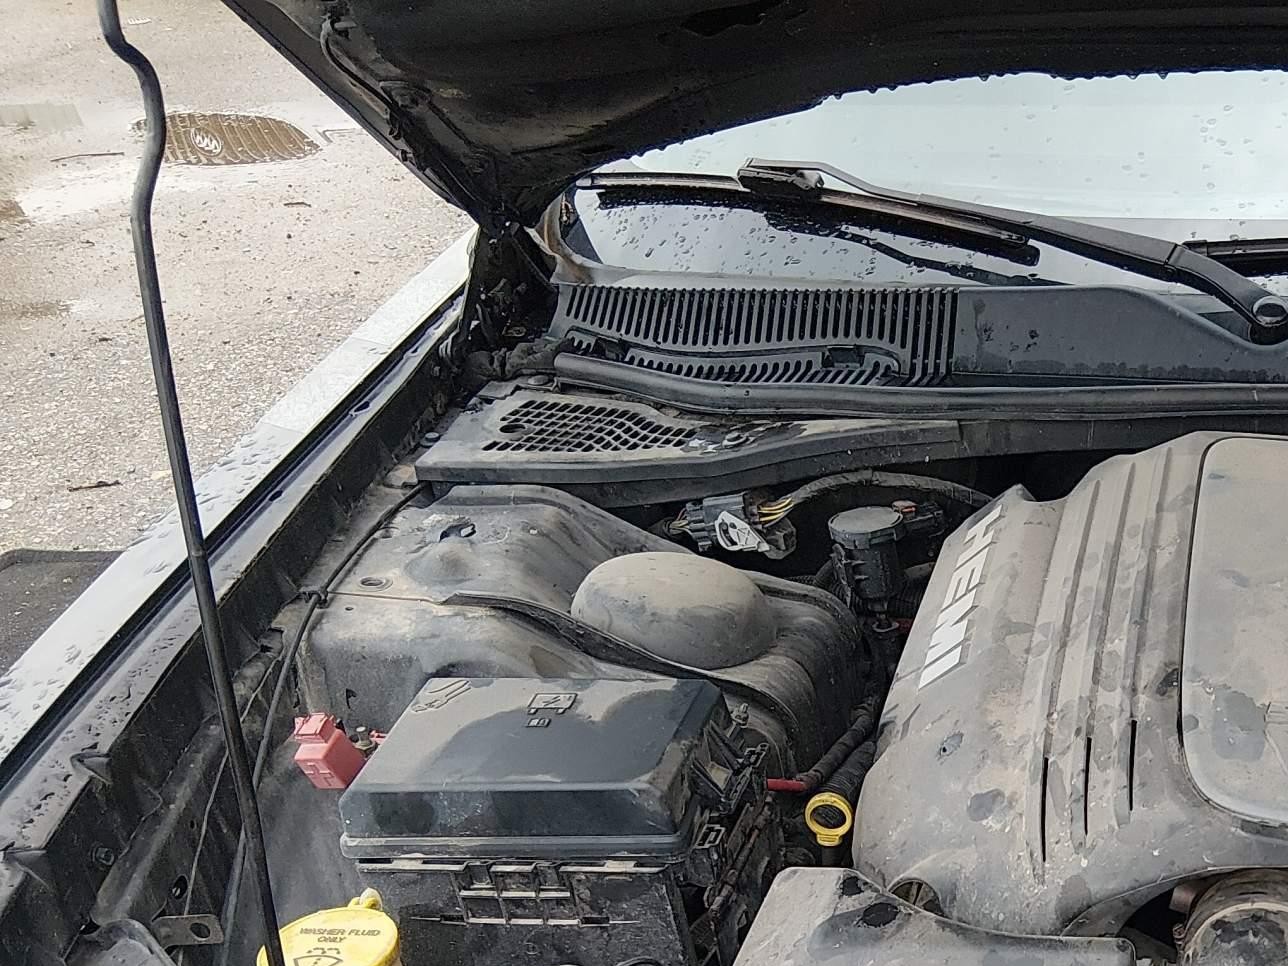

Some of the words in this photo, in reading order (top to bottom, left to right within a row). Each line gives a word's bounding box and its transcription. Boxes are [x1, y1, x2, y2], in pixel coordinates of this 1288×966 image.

[917, 504, 1003, 690] HEMI
[300, 928, 346, 936] WASHER
[347, 928, 381, 937] FLUID
